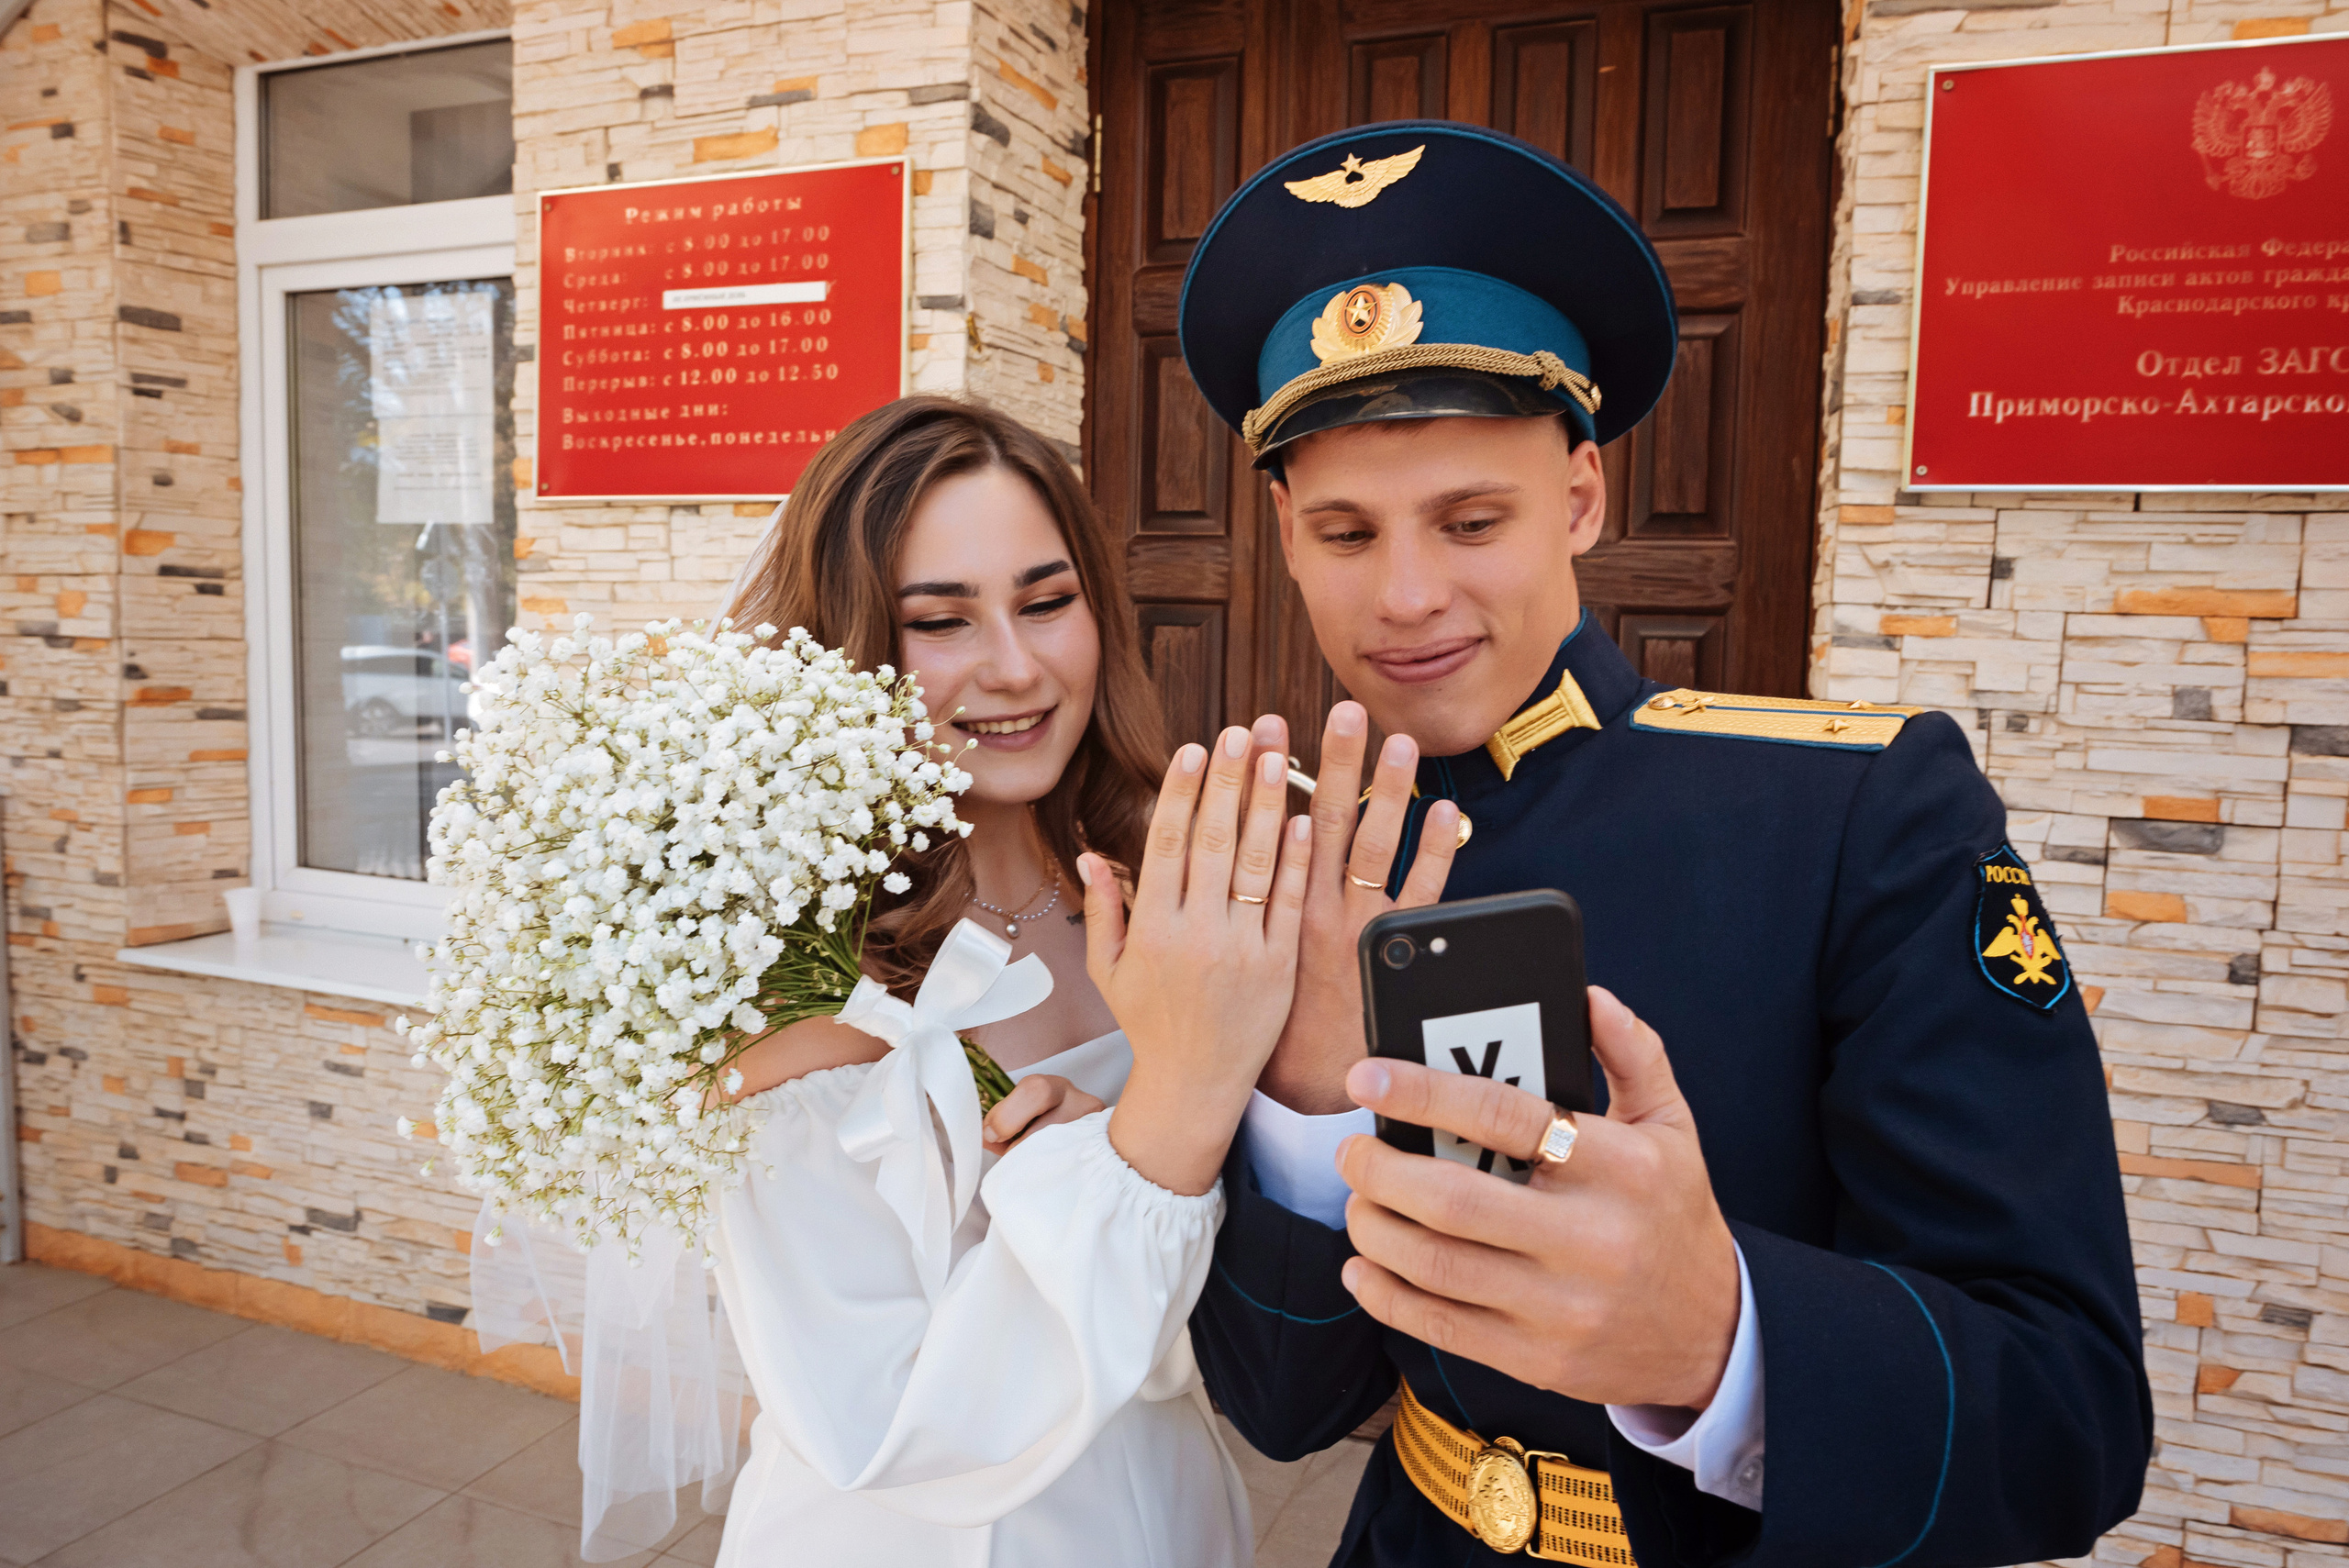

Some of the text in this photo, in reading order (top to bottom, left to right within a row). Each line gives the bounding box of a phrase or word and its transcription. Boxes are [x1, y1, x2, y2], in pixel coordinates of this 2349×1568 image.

[625, 196, 802, 225] Режим работы
[740, 235, 763, 248] до
[2109, 240, 2251, 262] Российская
[738, 261, 761, 275] до
[1944, 276, 2083, 300] Управление
[2092, 272, 2176, 290] записи
[2185, 270, 2254, 285] актов
[2117, 294, 2317, 318] Краснодарского
[682, 314, 729, 332] 8.00
[737, 316, 761, 329] до
[562, 348, 650, 368] Суббота:
[681, 340, 729, 359] 8.00
[737, 343, 761, 356] до
[769, 336, 829, 354] 17.00
[2136, 346, 2349, 379] Отдел ЗАГС
[681, 367, 737, 385] 12.00
[746, 370, 770, 383] до
[562, 404, 728, 424] Выходные дни:
[1966, 387, 2349, 424] Приморско-Ахтарско
